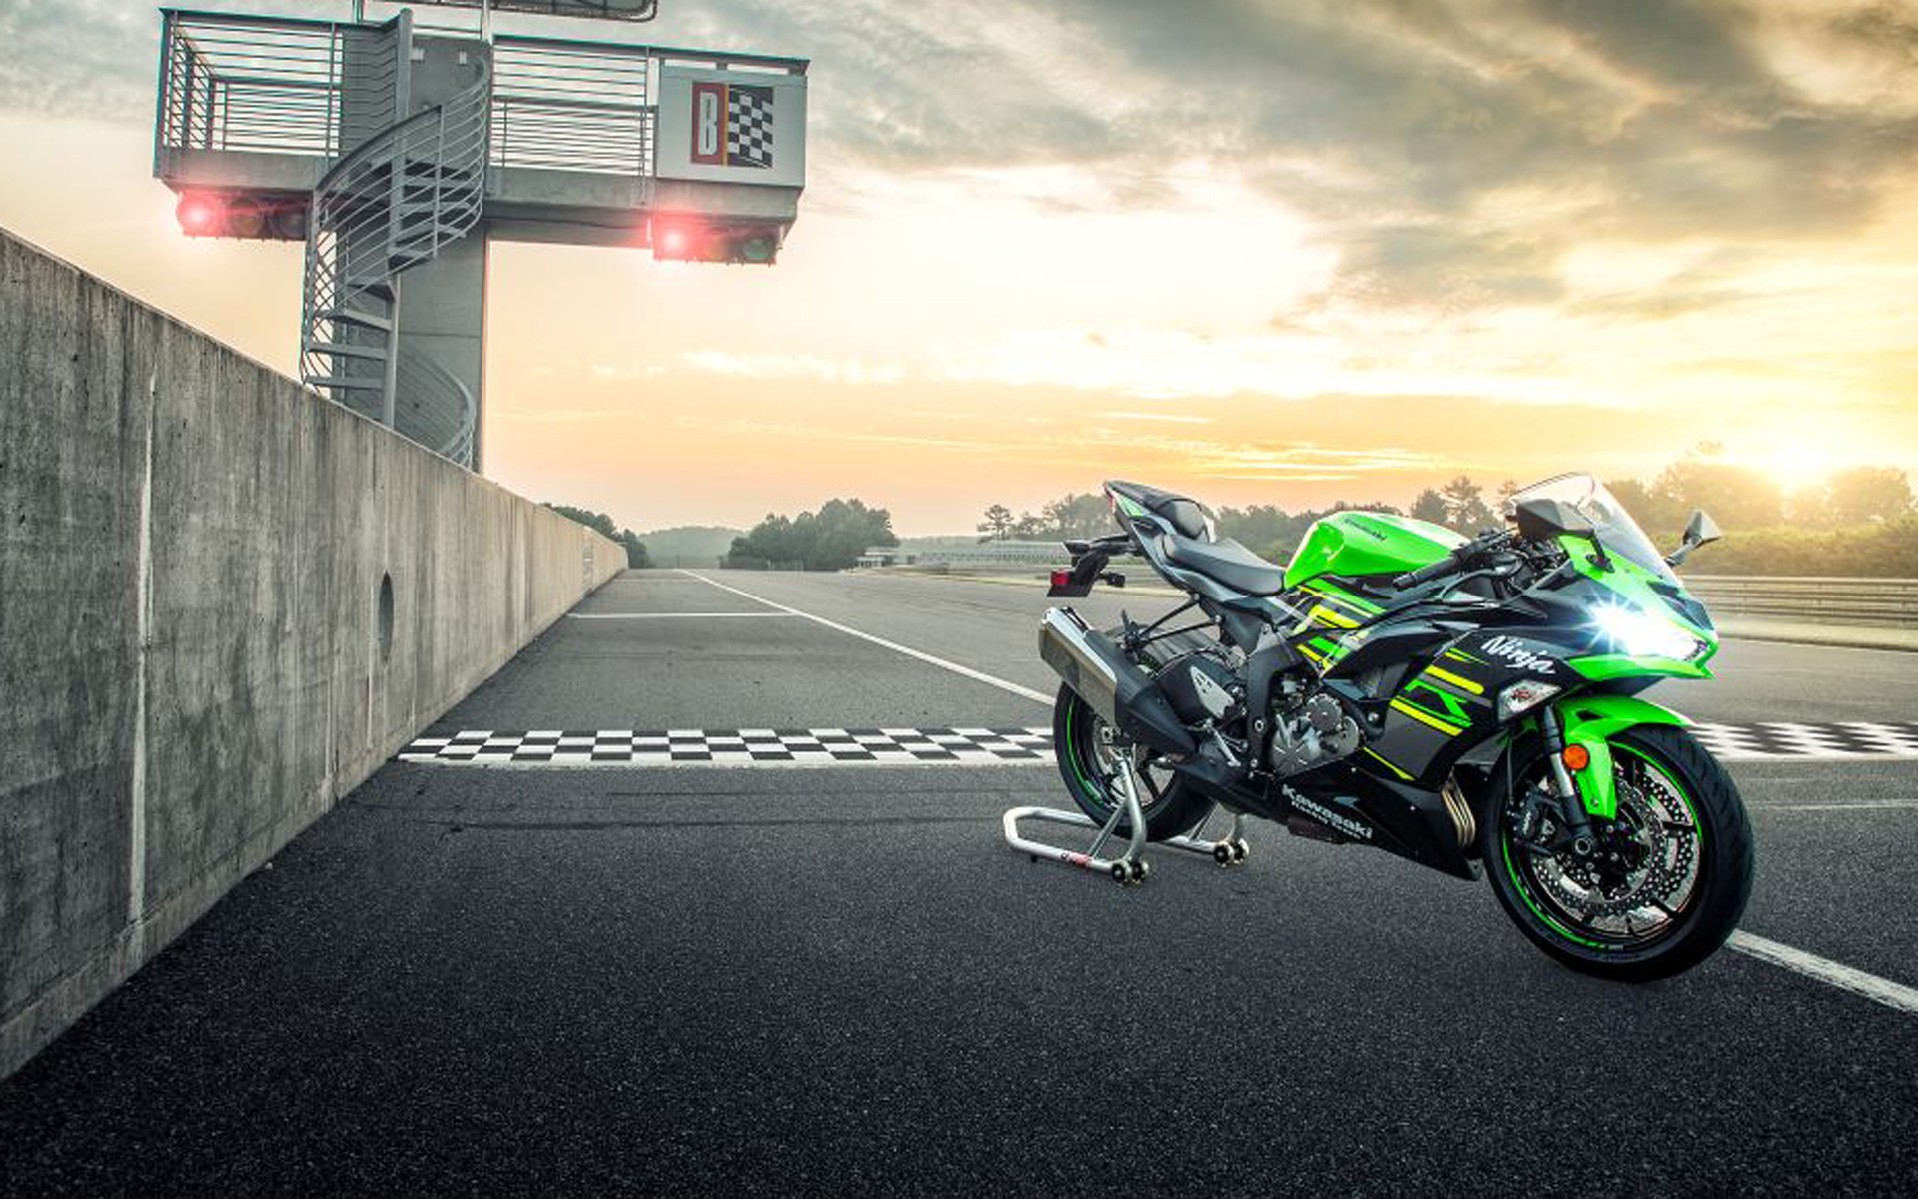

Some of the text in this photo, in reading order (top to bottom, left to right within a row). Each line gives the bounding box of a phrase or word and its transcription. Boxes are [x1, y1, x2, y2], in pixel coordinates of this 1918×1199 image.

[698, 91, 718, 156] B
[1481, 635, 1556, 675] Ninja
[1281, 783, 1373, 839] Kawasaki
